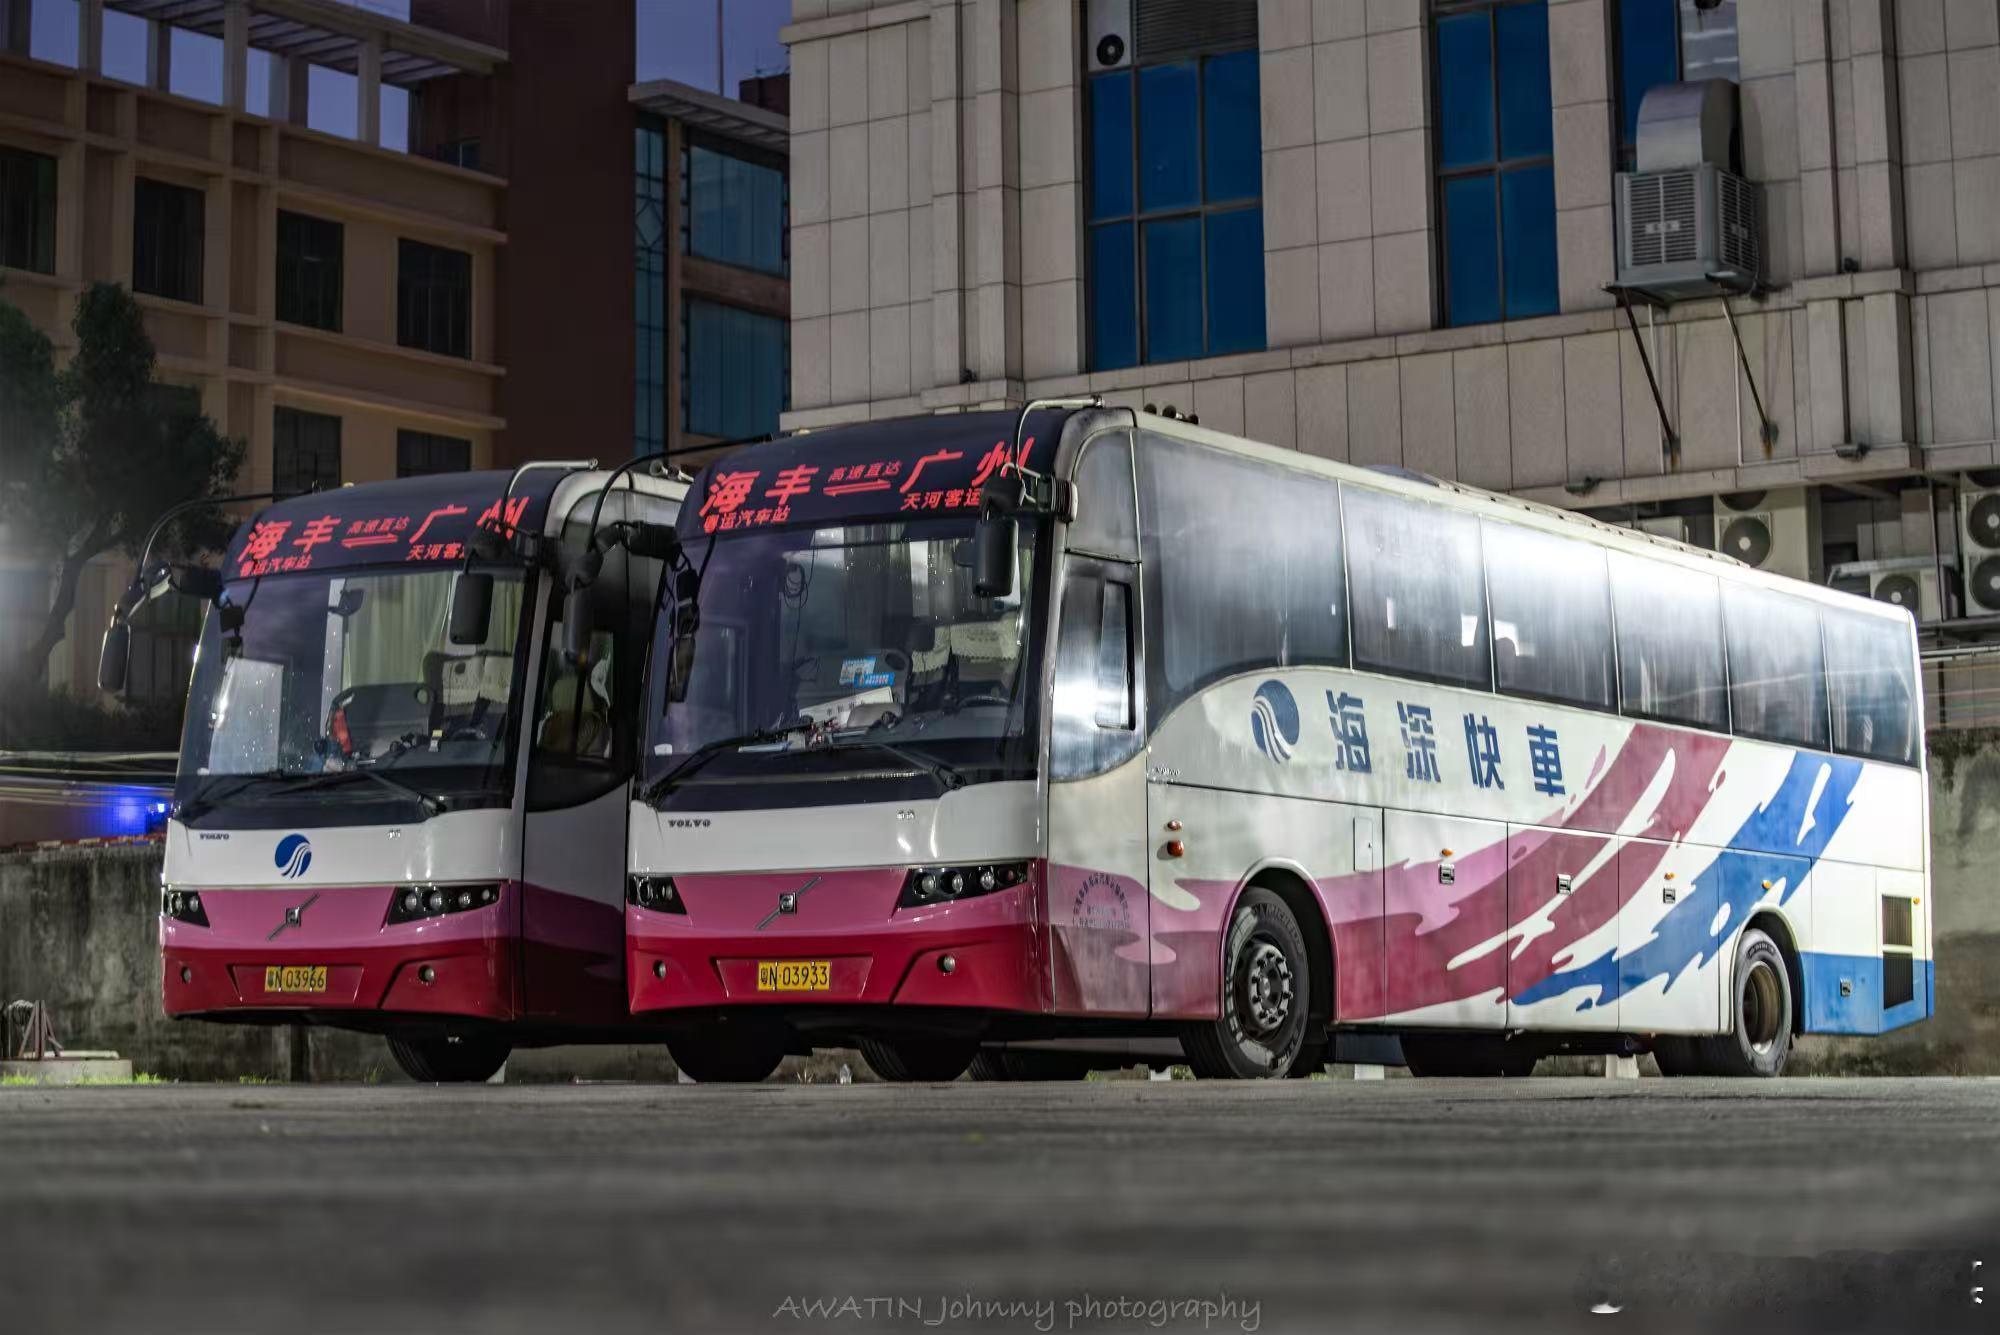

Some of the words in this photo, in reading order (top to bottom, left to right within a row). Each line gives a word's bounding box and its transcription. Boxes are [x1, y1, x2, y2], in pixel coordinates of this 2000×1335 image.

[699, 464, 820, 517] 海丰
[899, 437, 1035, 493] 广州
[828, 461, 903, 483] 高速直达
[237, 515, 342, 562] 海丰
[406, 543, 464, 561] 天河客
[1326, 689, 1566, 797] 海深快車
[668, 819, 711, 828] VOLVO
